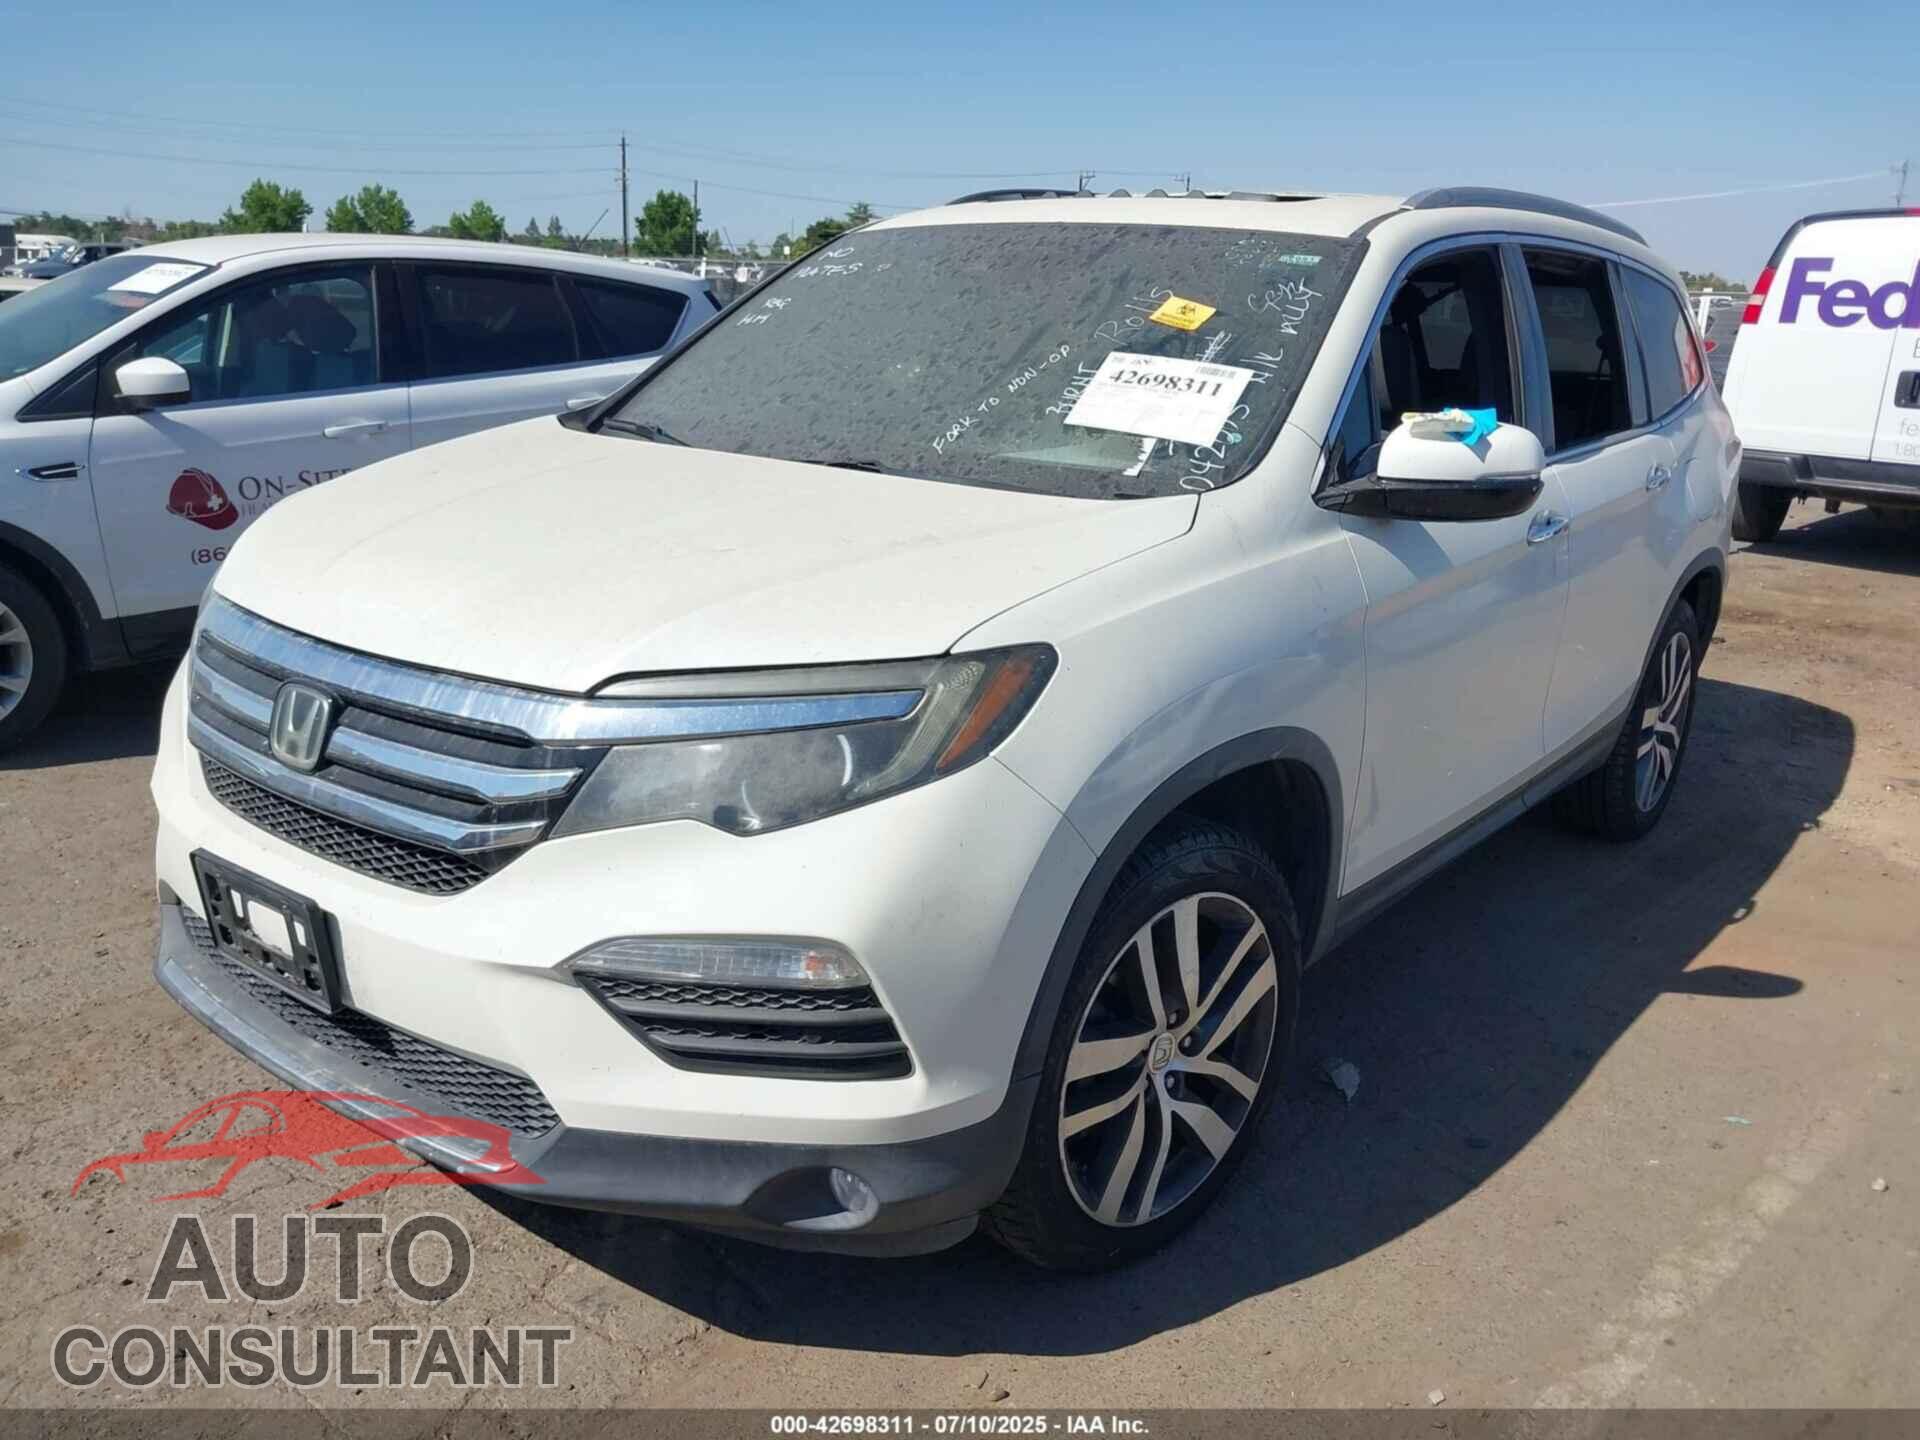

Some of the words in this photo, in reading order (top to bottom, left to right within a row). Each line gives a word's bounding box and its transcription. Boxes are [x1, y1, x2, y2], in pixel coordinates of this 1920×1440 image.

[1109, 368, 1224, 397] 42698311
[932, 416, 980, 455] FORK
[977, 397, 1000, 413] TO
